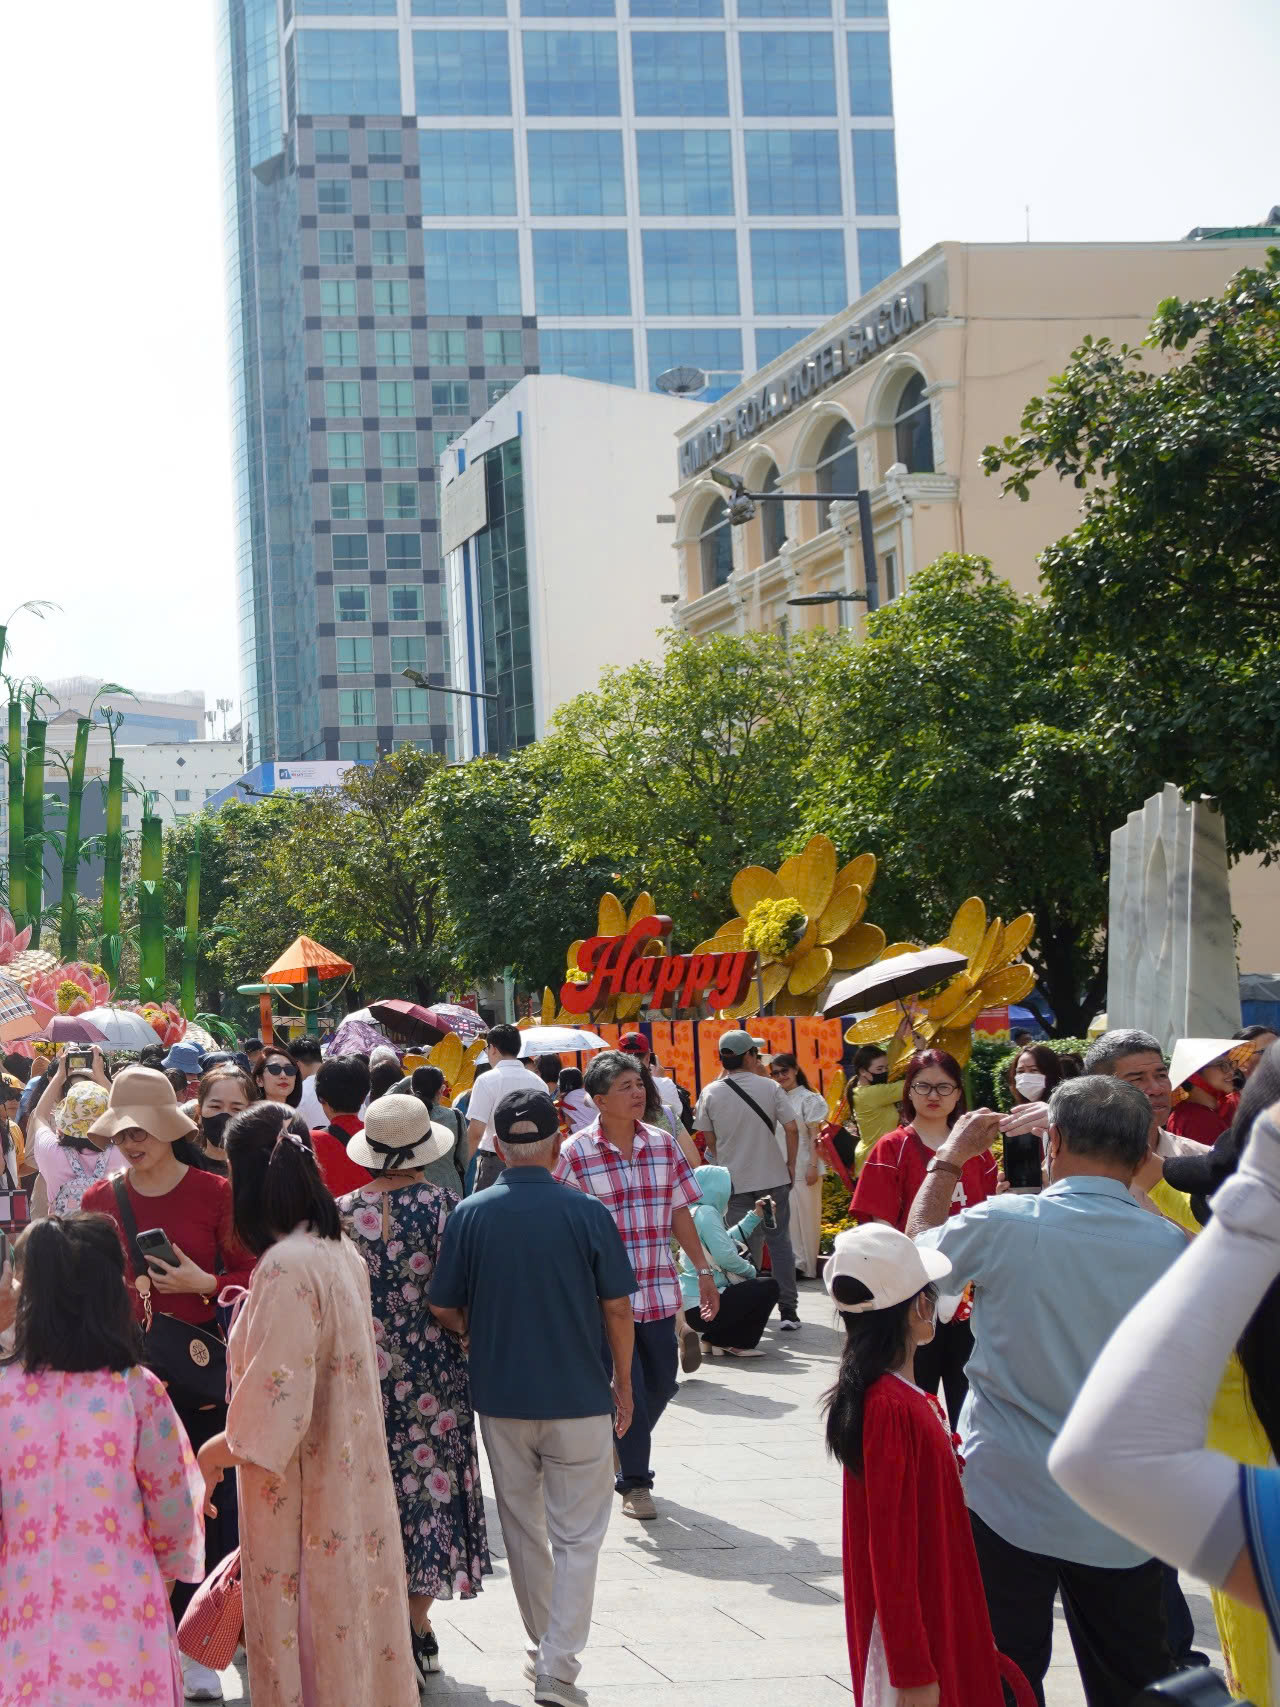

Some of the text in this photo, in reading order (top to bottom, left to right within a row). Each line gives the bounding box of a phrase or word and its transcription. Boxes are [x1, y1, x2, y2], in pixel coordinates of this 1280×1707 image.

[736, 379, 785, 440] ROYAL
[788, 342, 844, 404] HOTEL
[848, 284, 926, 365] SAIGON
[560, 914, 758, 1014] Happy
